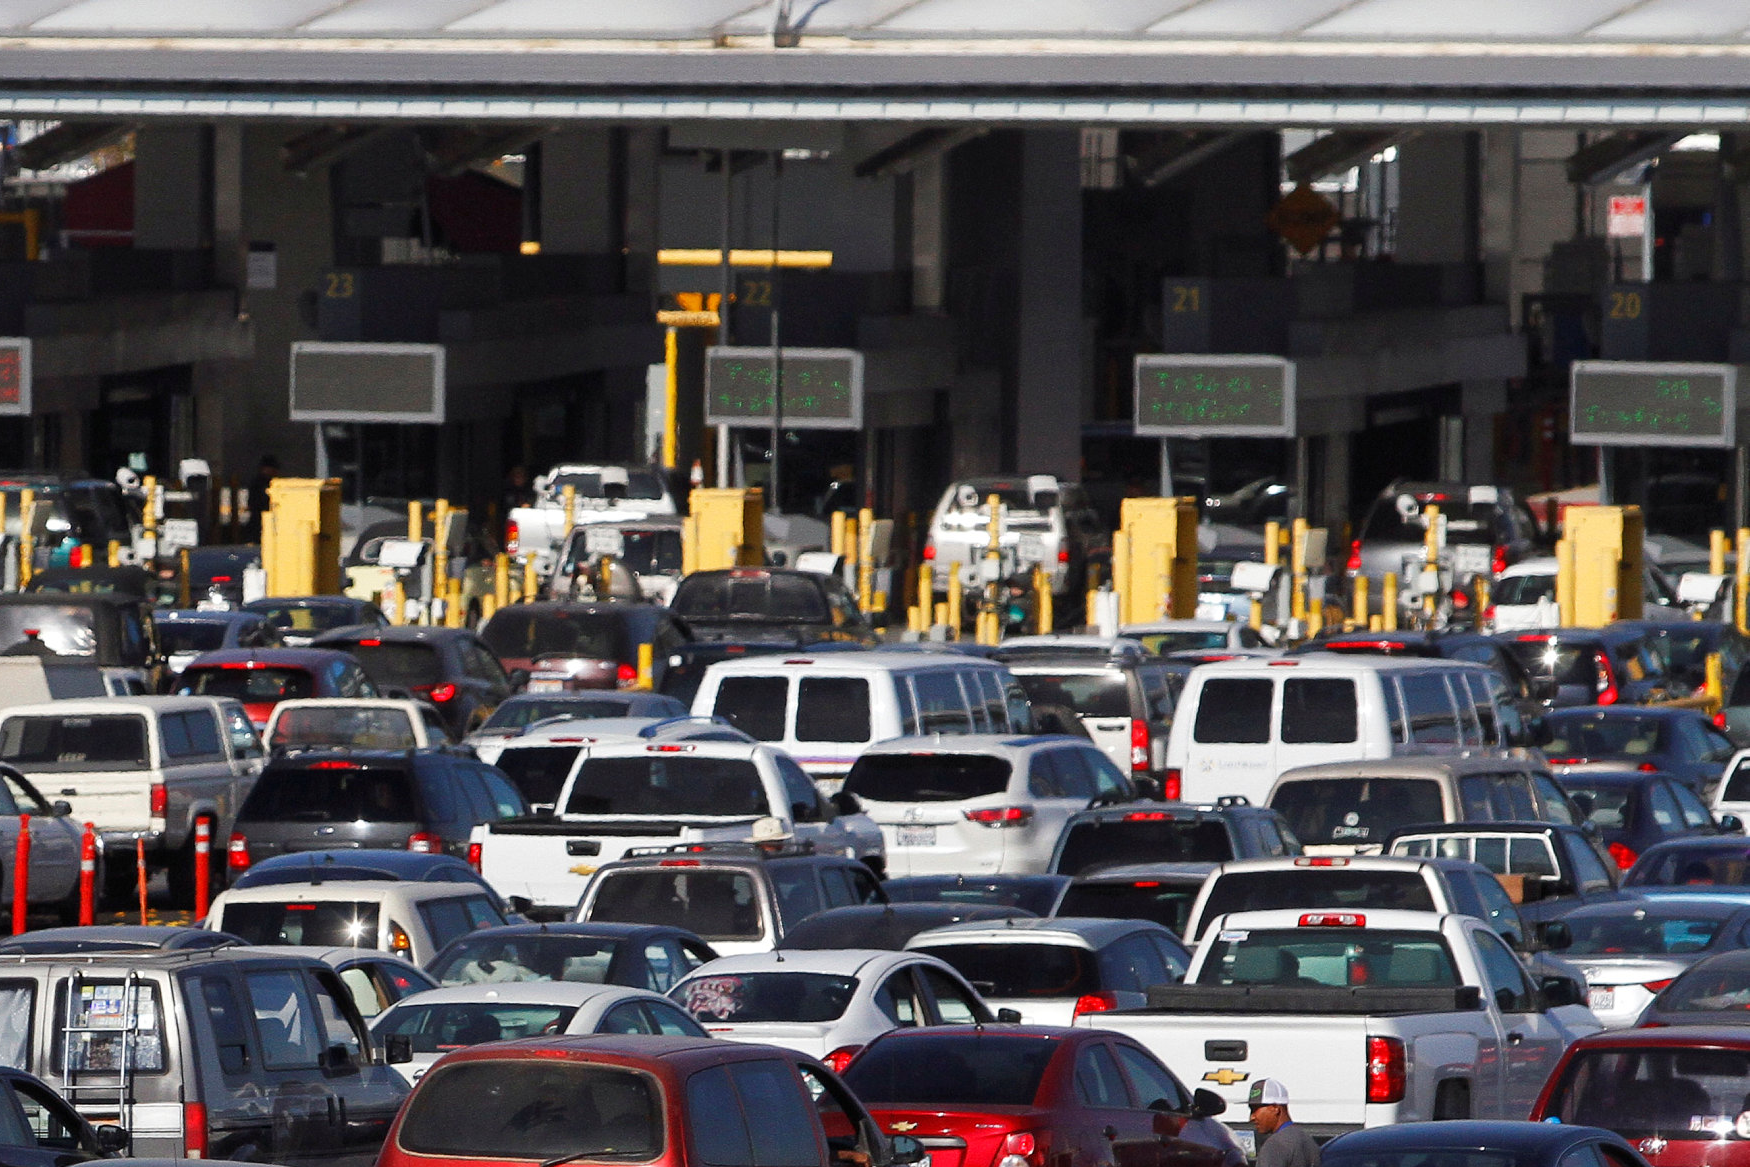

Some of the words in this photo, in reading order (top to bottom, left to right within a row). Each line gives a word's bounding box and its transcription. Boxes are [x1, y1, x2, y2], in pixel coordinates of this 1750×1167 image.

[326, 272, 354, 298] 23
[1172, 286, 1200, 312] 21
[1610, 292, 1641, 319] 20
